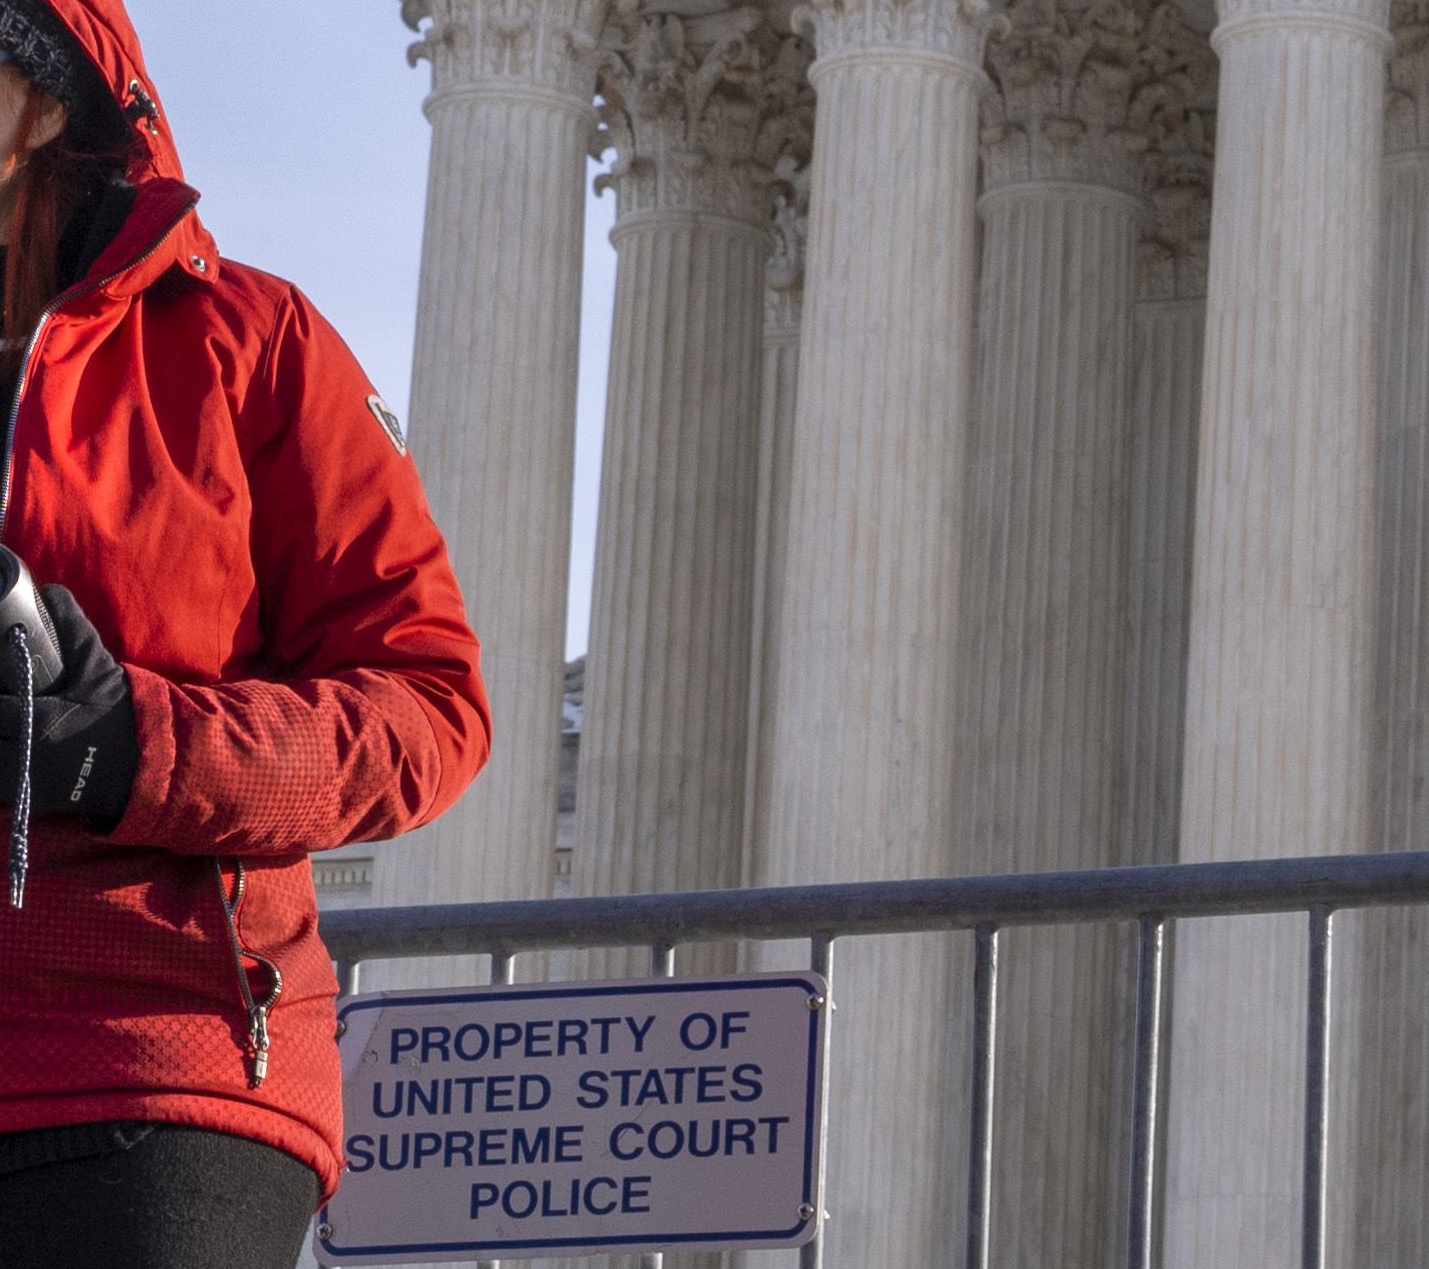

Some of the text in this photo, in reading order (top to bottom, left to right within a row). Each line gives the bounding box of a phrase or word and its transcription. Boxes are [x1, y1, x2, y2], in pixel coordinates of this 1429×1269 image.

[70, 746, 98, 802] HEAD
[389, 1011, 751, 1065] PROPERTY OF
[372, 1063, 764, 1119] UNITED STATES
[346, 1116, 790, 1173] SUPREME COURT
[470, 1175, 652, 1220] POLICE
